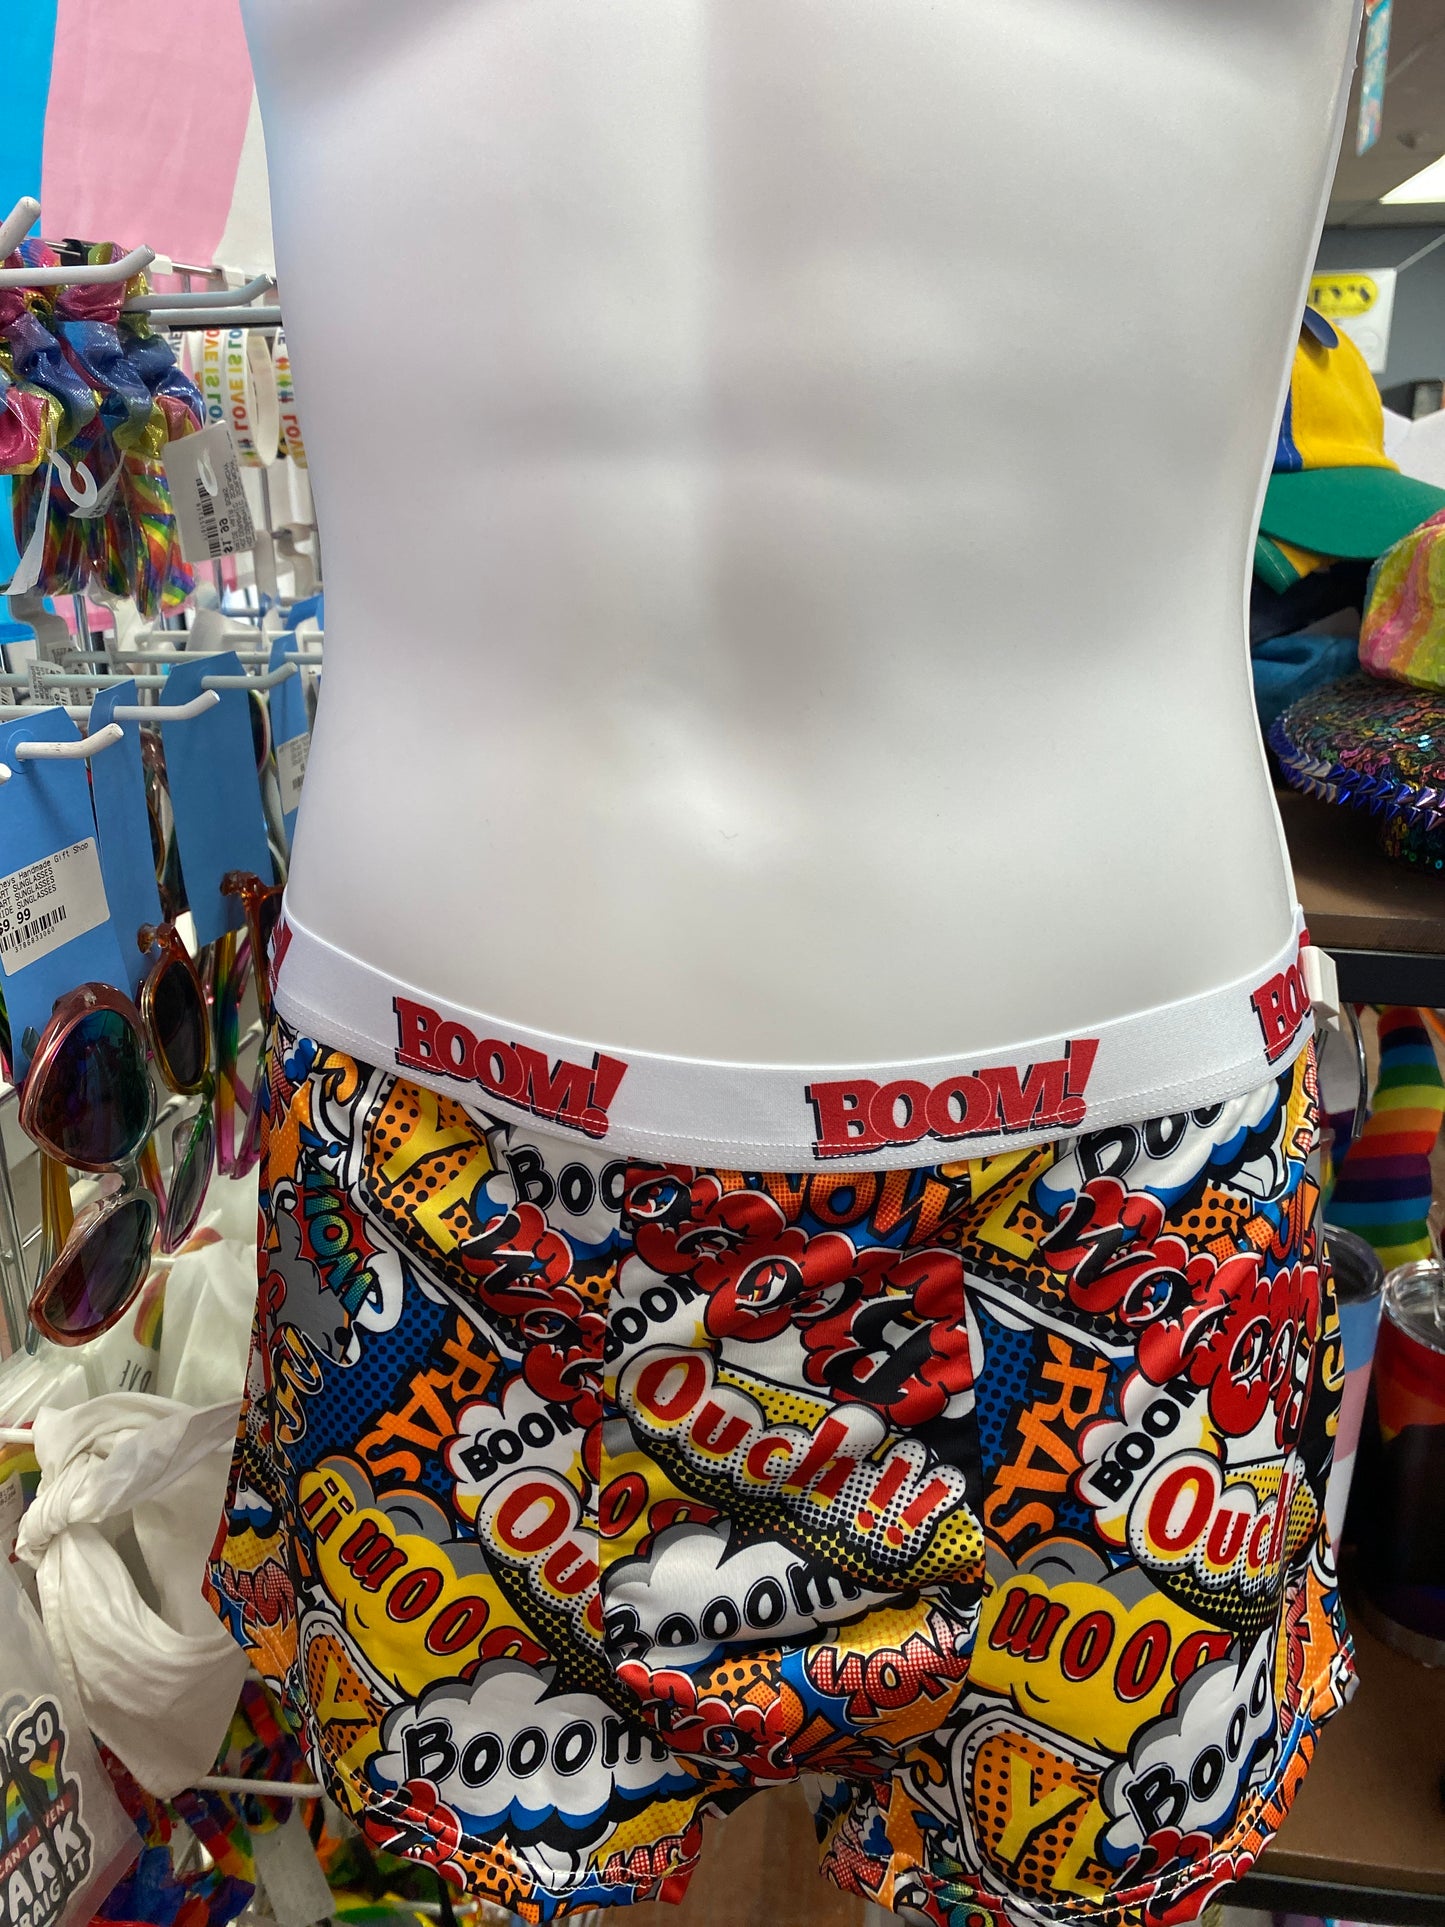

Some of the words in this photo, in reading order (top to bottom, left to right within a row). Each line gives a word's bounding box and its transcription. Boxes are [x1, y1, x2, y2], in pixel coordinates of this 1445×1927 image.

[12, 867, 53, 892] SUNGLASSES
[18, 860, 51, 879] Handmade
[53, 850, 70, 863] Gift
[72, 842, 89, 854] Shop
[14, 875, 55, 901] SUNGLASSES
[17, 883, 57, 910] SUNGLASSES
[392, 996, 629, 1139] BOOM!
[804, 1038, 1100, 1160] BOOM!
[634, 1356, 950, 1549] Ouch!!
[18, 1710, 54, 1764] SO
[0, 1738, 60, 1846] AY
